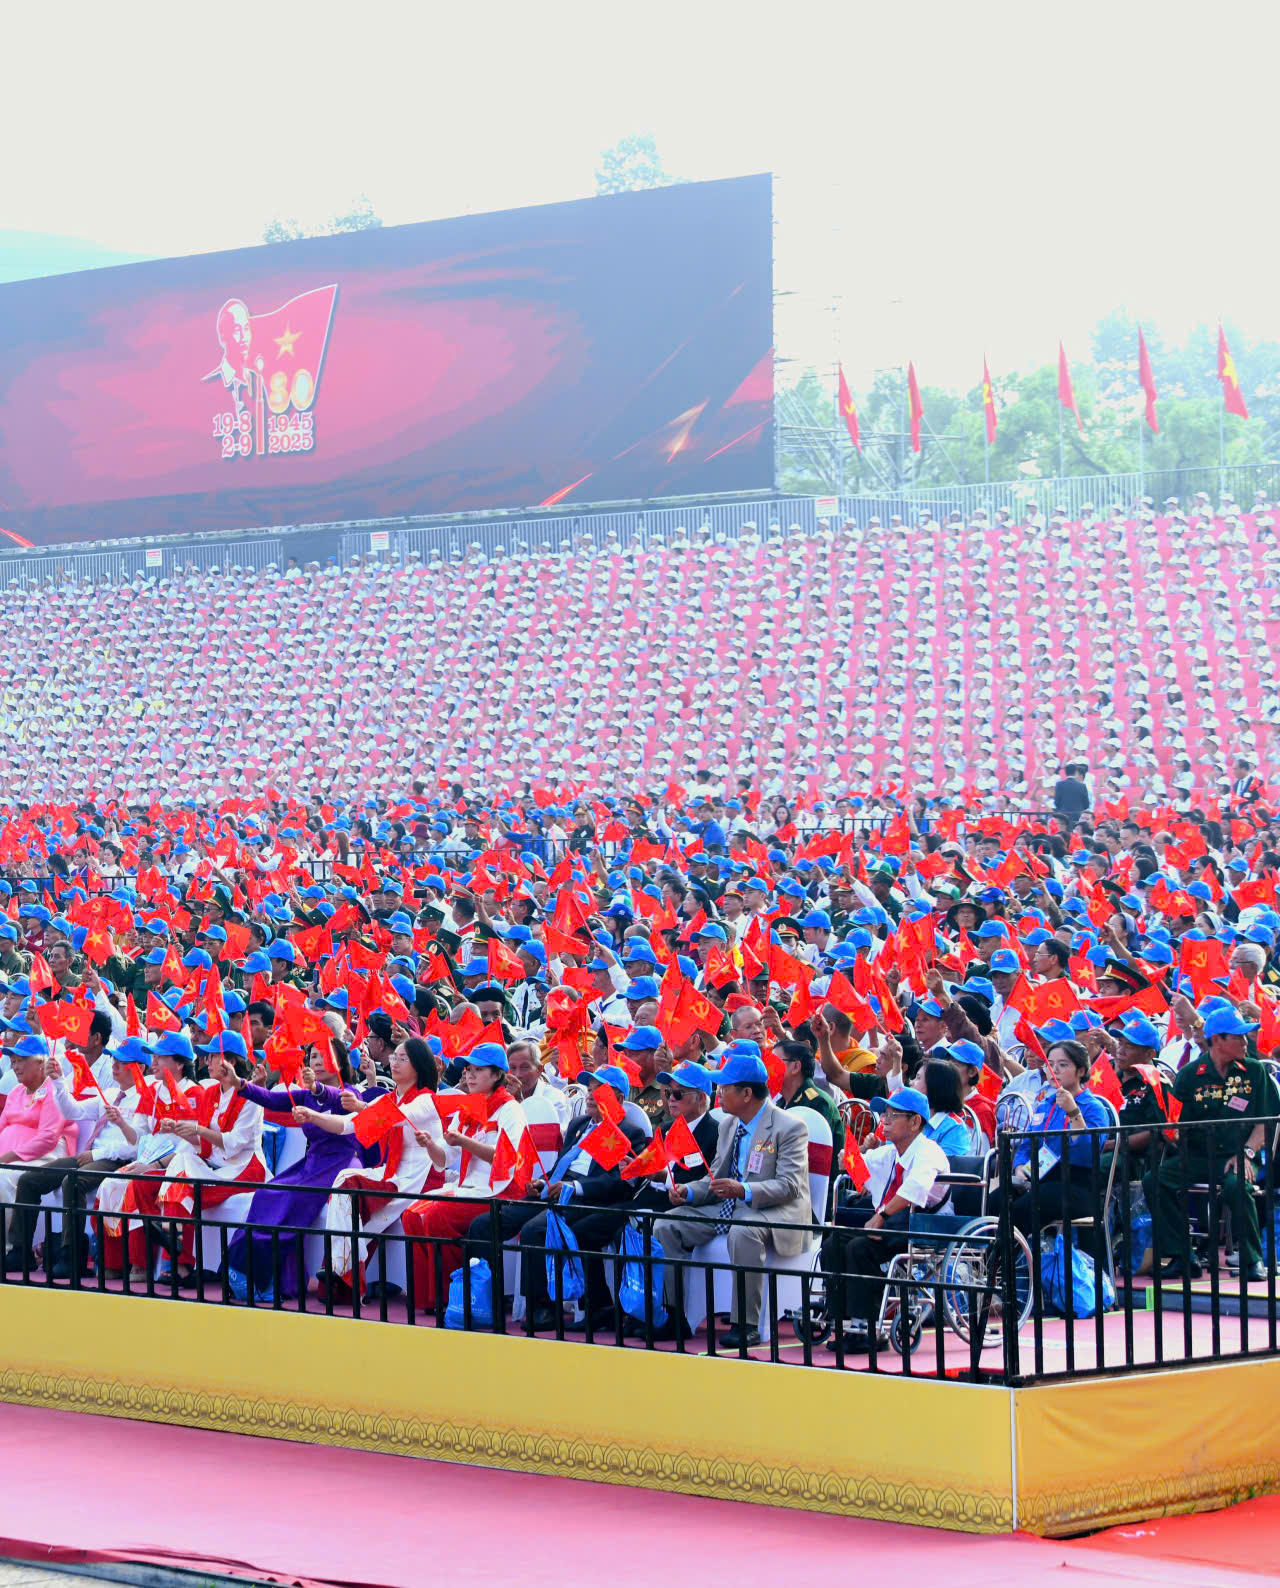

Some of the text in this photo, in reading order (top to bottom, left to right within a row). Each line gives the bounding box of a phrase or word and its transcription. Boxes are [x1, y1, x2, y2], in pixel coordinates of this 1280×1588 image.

[269, 369, 314, 414] 80
[268, 412, 313, 435] 1945
[268, 431, 313, 453] 2025
